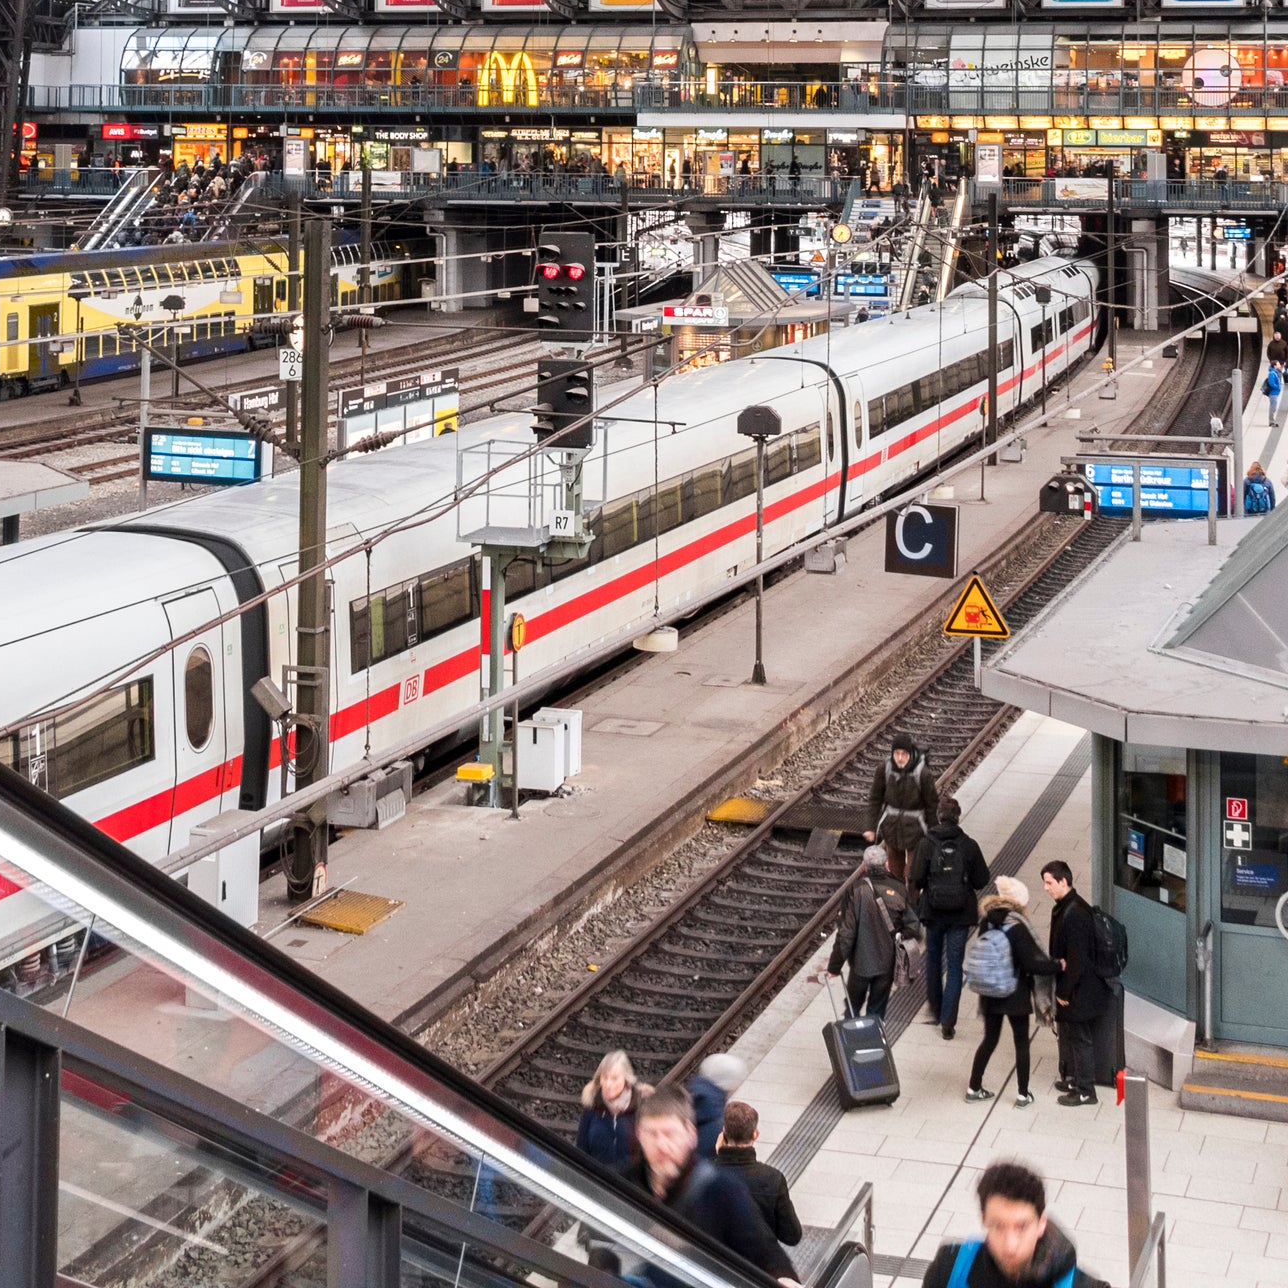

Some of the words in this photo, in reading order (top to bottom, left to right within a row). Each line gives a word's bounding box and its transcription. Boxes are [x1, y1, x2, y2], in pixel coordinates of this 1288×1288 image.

[438, 56, 450, 64] 24
[108, 128, 125, 136] AVIS
[621, 249, 631, 262] E
[673, 307, 713, 317] SPAR
[282, 350, 303, 363] 286
[288, 364, 297, 377] 6
[1139, 476, 1172, 486] üdkreuz
[895, 504, 934, 560] C
[405, 680, 418, 700] DB
